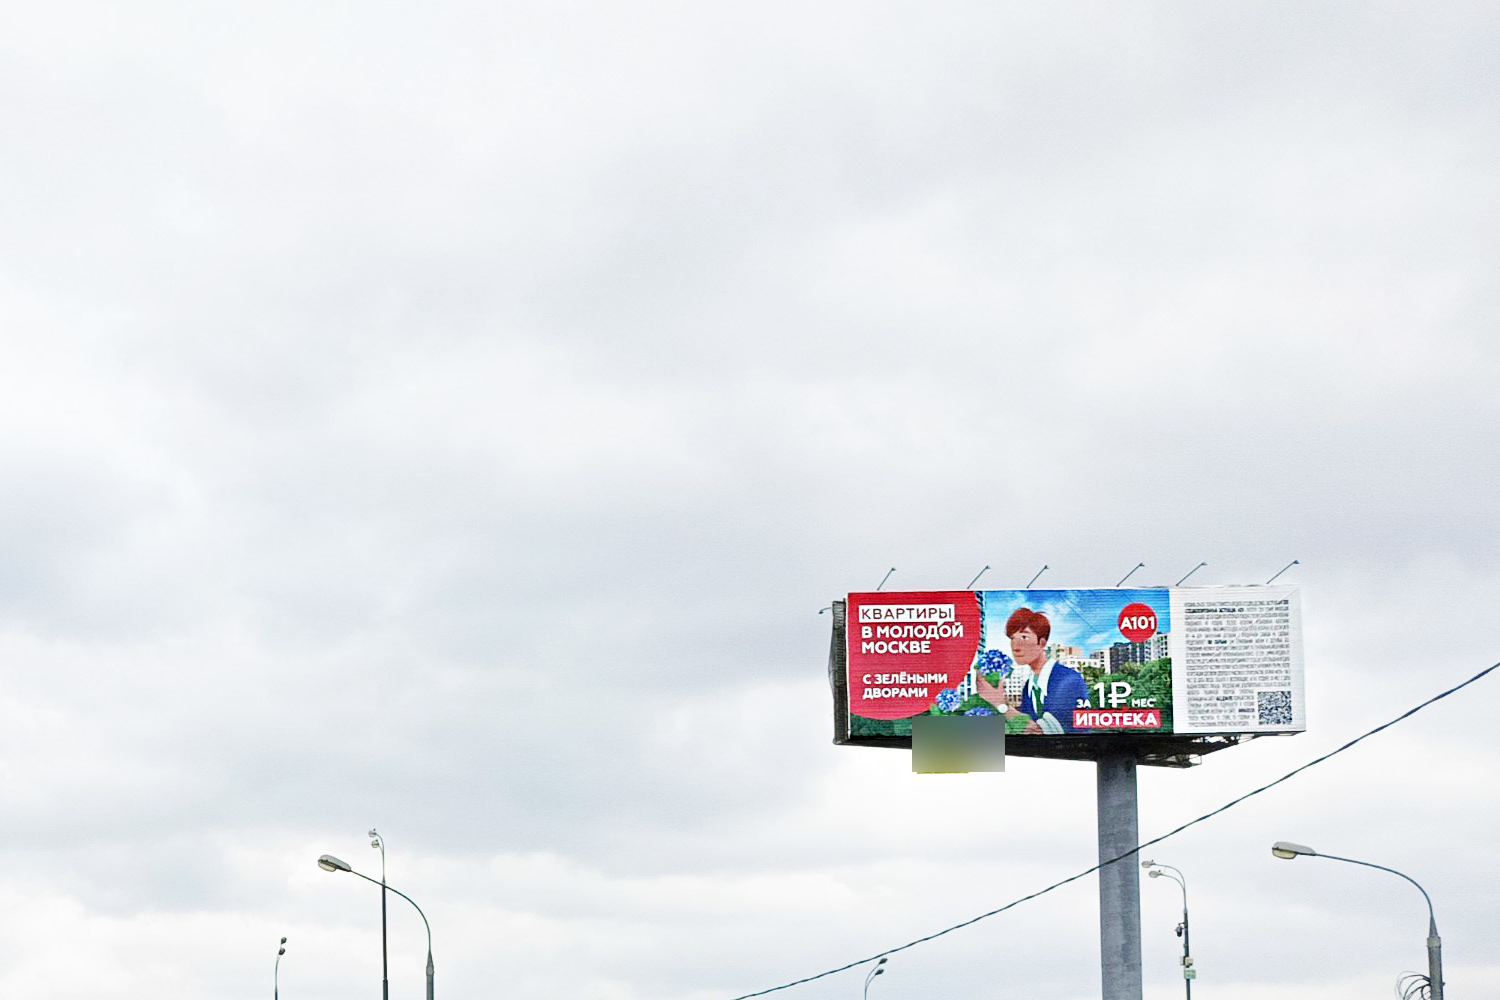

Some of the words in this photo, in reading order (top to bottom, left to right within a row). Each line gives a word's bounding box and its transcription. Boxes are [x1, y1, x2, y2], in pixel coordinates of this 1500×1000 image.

[861, 607, 952, 620] КВАРТИРЫ
[861, 625, 873, 639] В
[876, 622, 964, 640] МОЛОДОЙ
[861, 640, 932, 654] МОСКВЕ
[862, 673, 872, 685] С
[874, 671, 948, 685] ЗЕЛЁНЫМИ
[862, 687, 928, 700] ДВОРАМИ
[1075, 712, 1158, 726] ИПОТЕКА
